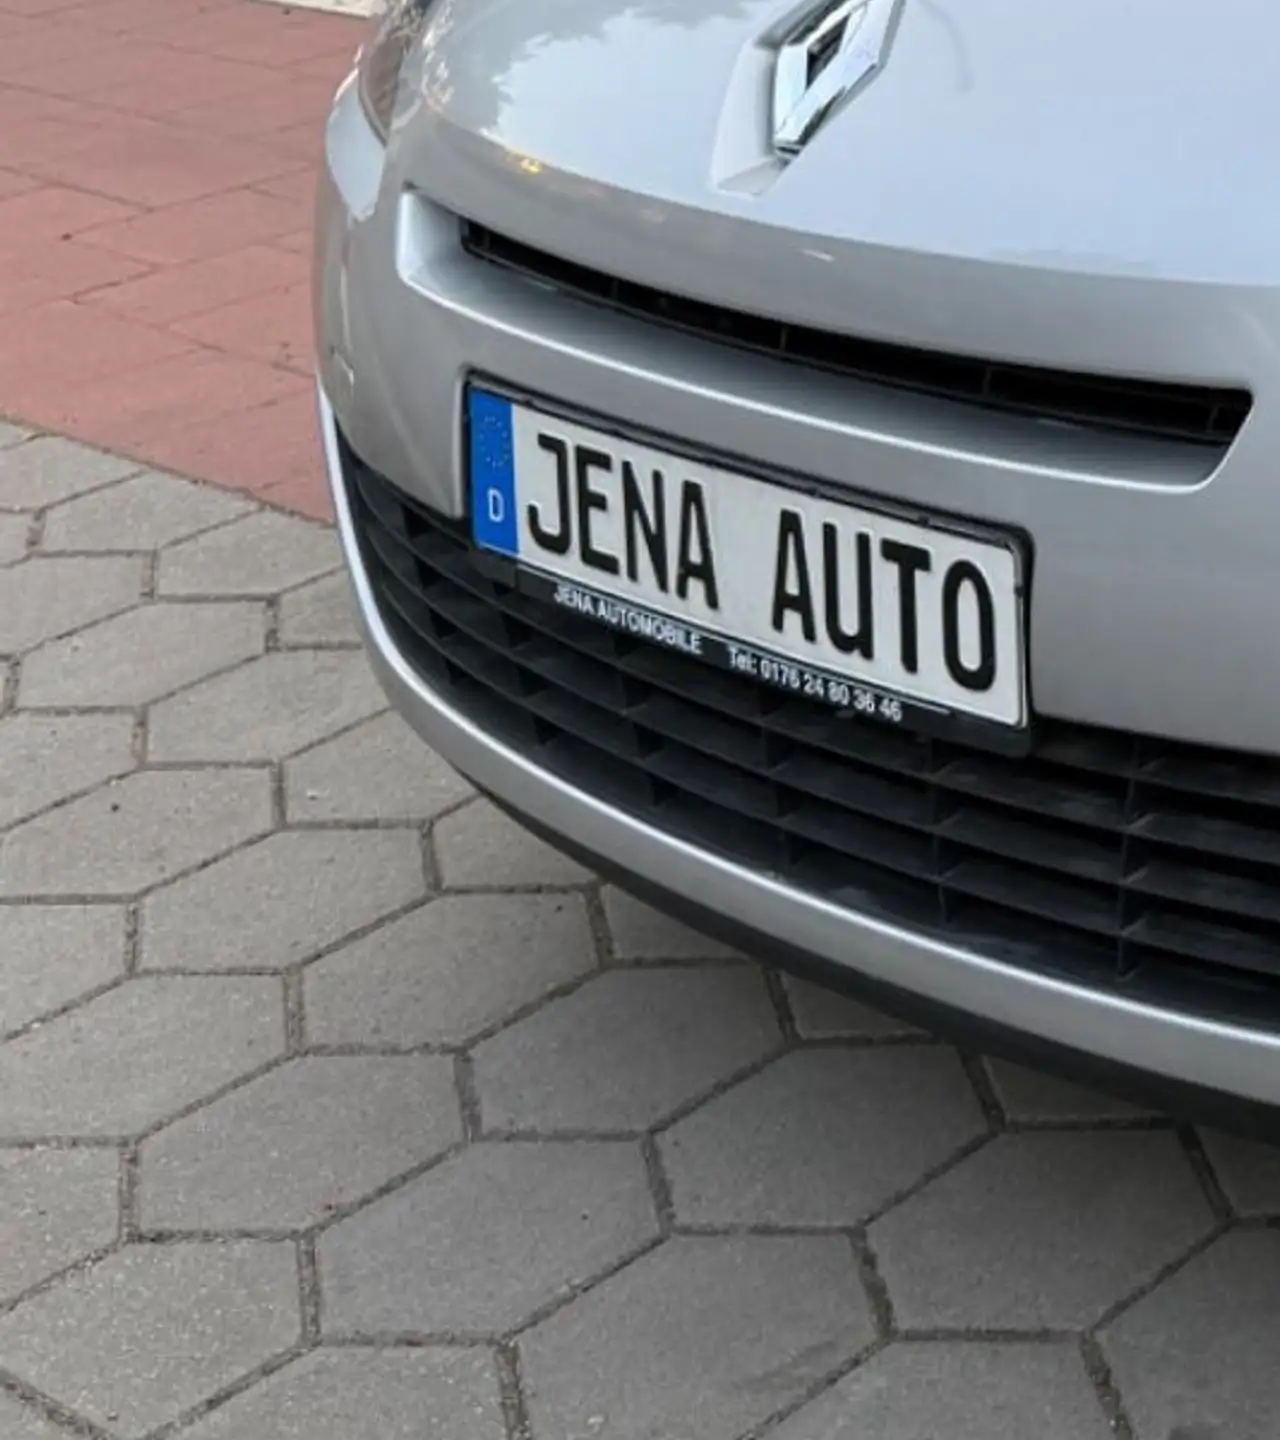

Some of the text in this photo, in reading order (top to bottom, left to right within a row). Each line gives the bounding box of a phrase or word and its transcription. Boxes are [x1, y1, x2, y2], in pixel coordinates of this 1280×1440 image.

[487, 486, 506, 524] D
[526, 432, 997, 693] JENA AUTO
[554, 582, 595, 615] JENA
[596, 598, 703, 655] AUTOMOBILE
[760, 659, 801, 690] 0176
[803, 672, 824, 699] 24
[878, 696, 902, 722] 46
